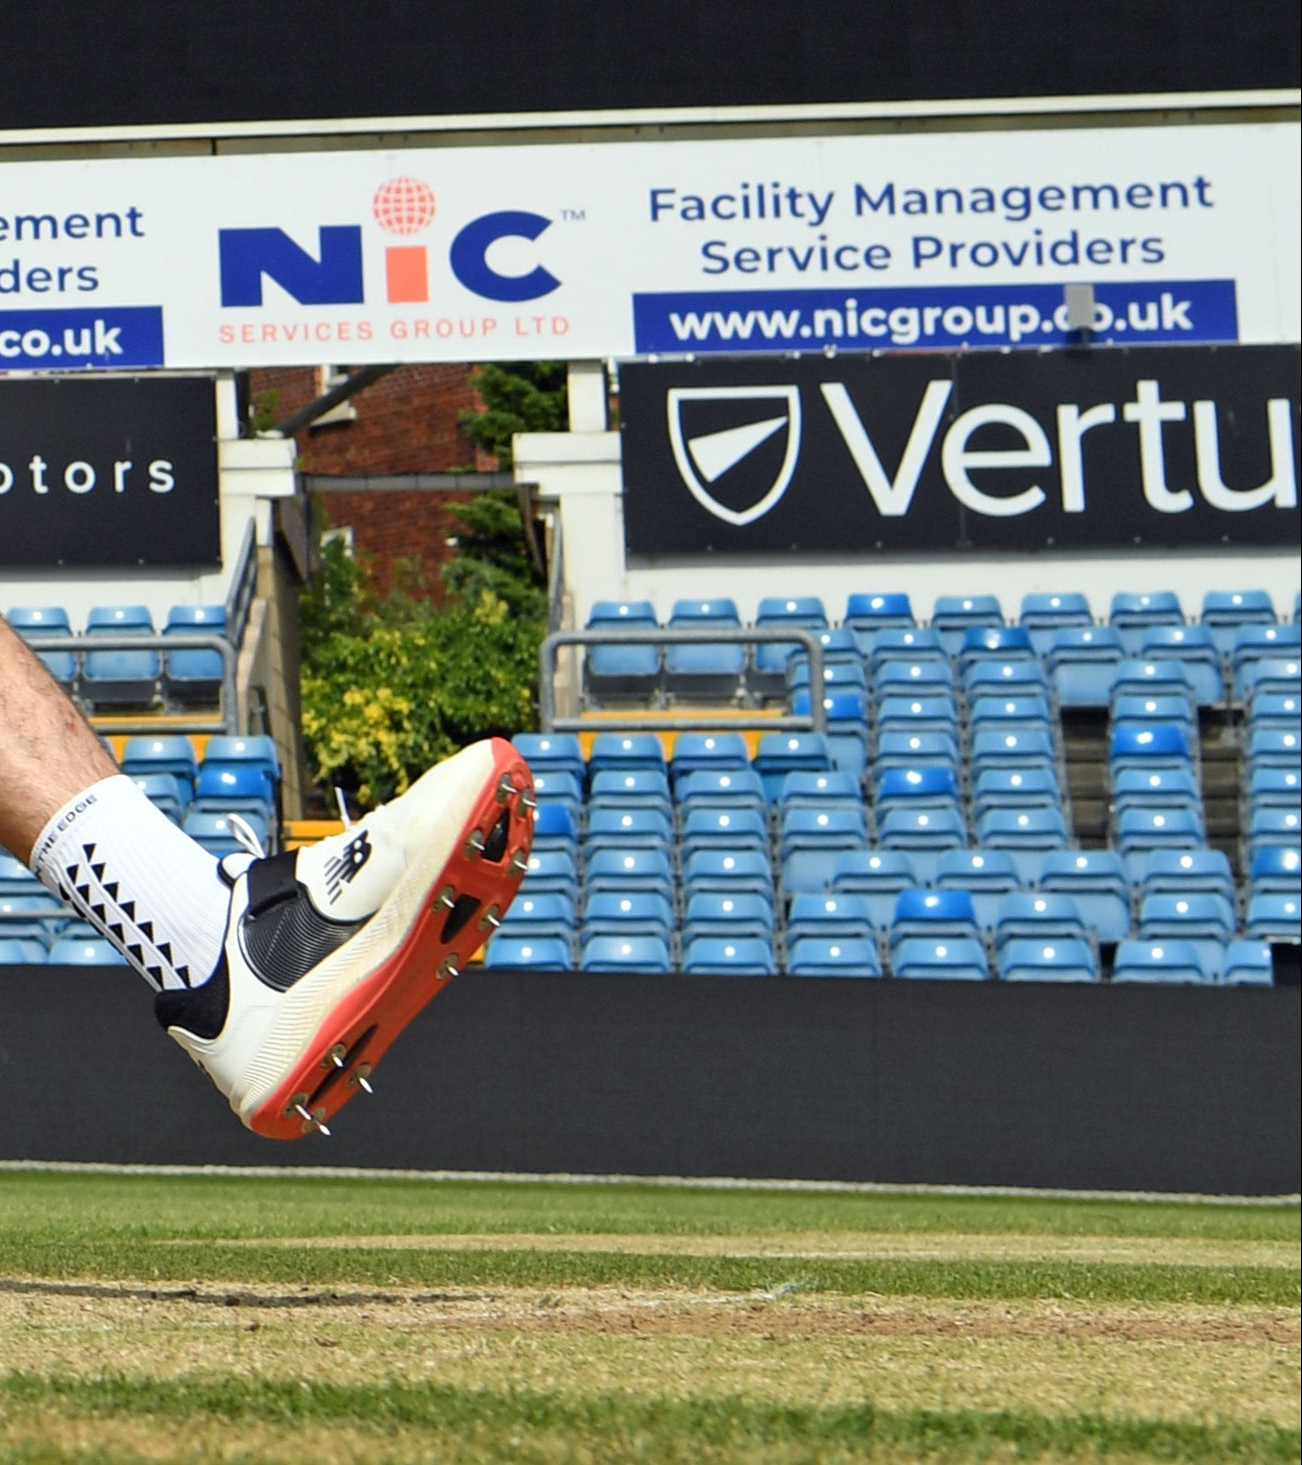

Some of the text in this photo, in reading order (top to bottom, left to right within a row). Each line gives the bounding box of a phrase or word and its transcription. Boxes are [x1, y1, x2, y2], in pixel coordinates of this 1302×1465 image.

[650, 175, 1214, 227] Facility Management
[701, 229, 1165, 274] Service Providers
[220, 316, 570, 344] SERVICES GROUP LTD
[669, 293, 1194, 344] www.nicgroup.co.uk
[820, 379, 1297, 517] Vertu
